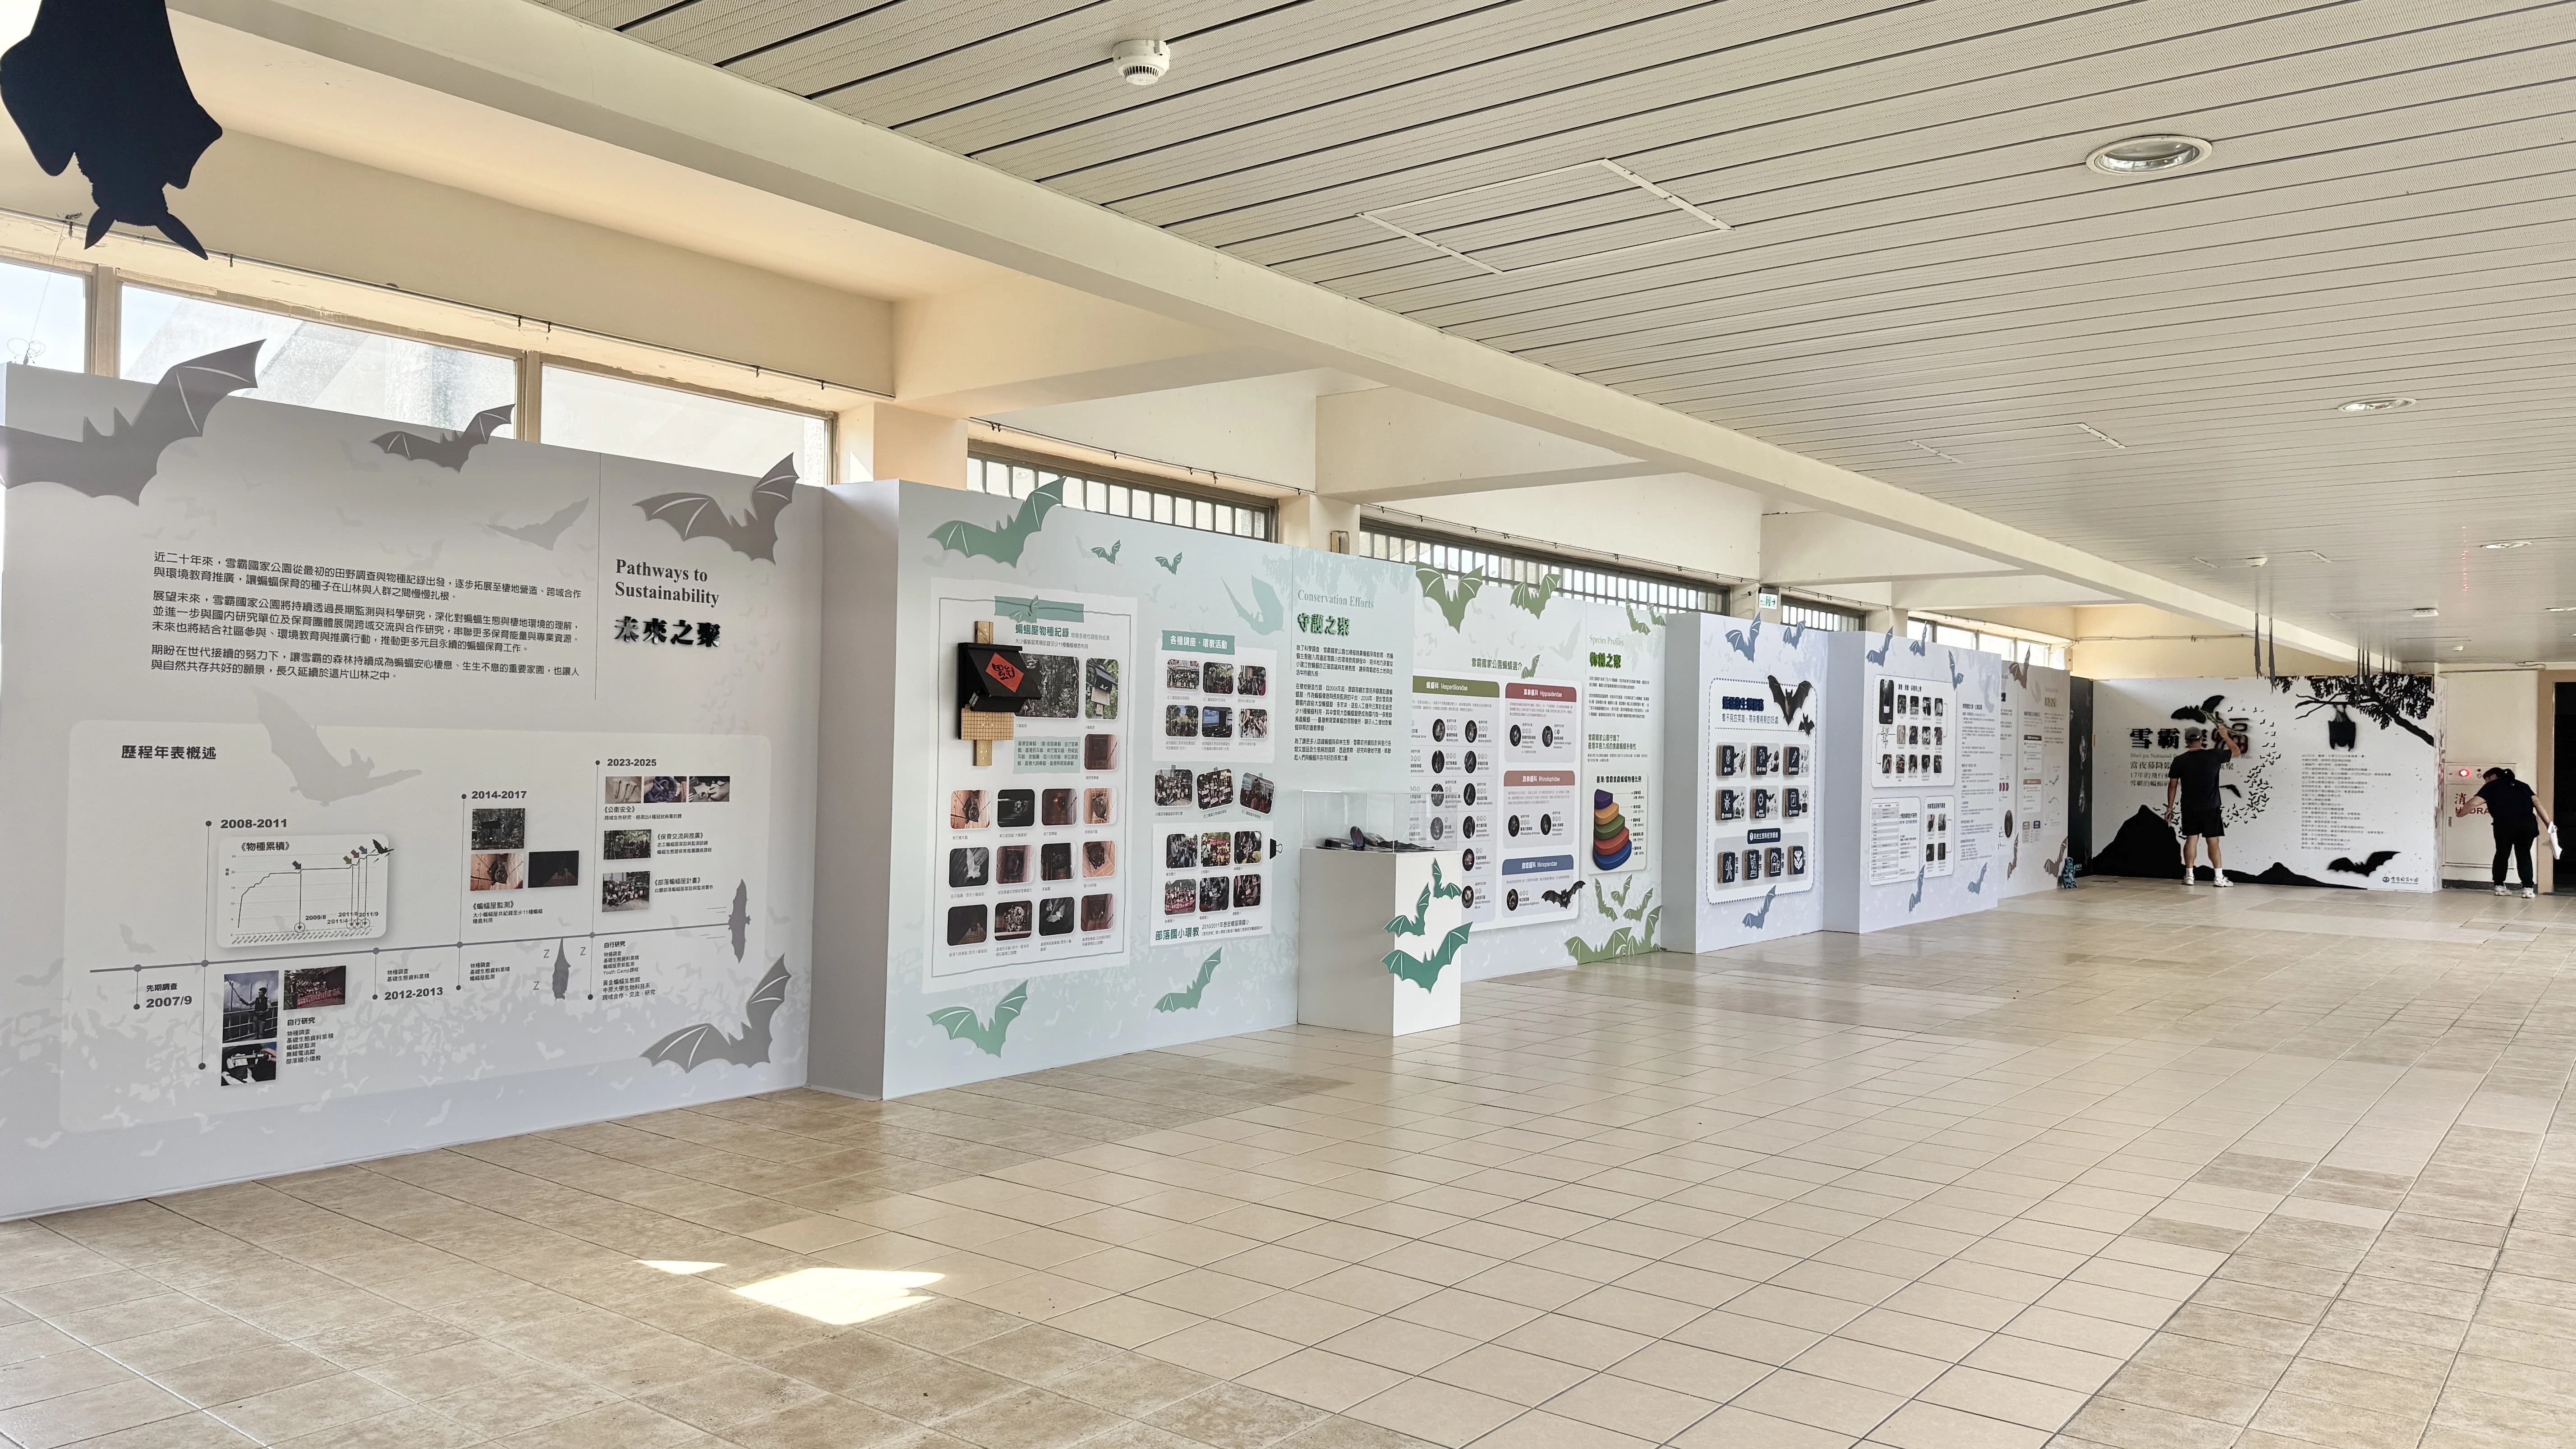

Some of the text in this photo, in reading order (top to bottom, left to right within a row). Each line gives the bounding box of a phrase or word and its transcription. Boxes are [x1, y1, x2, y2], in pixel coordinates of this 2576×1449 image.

[616, 559, 708, 583] Pathways to
[615, 581, 719, 608] Sustainability
[1298, 589, 1374, 609] Conservation Efforts
[1297, 613, 1350, 636] 守護之聚
[614, 616, 721, 647] 未來之聚
[1590, 635, 1624, 646] Species Profiles
[121, 745, 217, 760] 歷程年表概述
[607, 758, 657, 767] 2023-2025
[471, 790, 527, 799] 2014-2017
[220, 819, 287, 828] 2008-2011
[241, 842, 290, 851] 《物種累積》
[1155, 926, 1200, 941] 部落國小環教
[146, 983, 178, 992] 先期調查
[385, 987, 443, 1000] 2012-2013
[146, 996, 193, 1008] 2007/9
[287, 1017, 315, 1026] 自行研究
